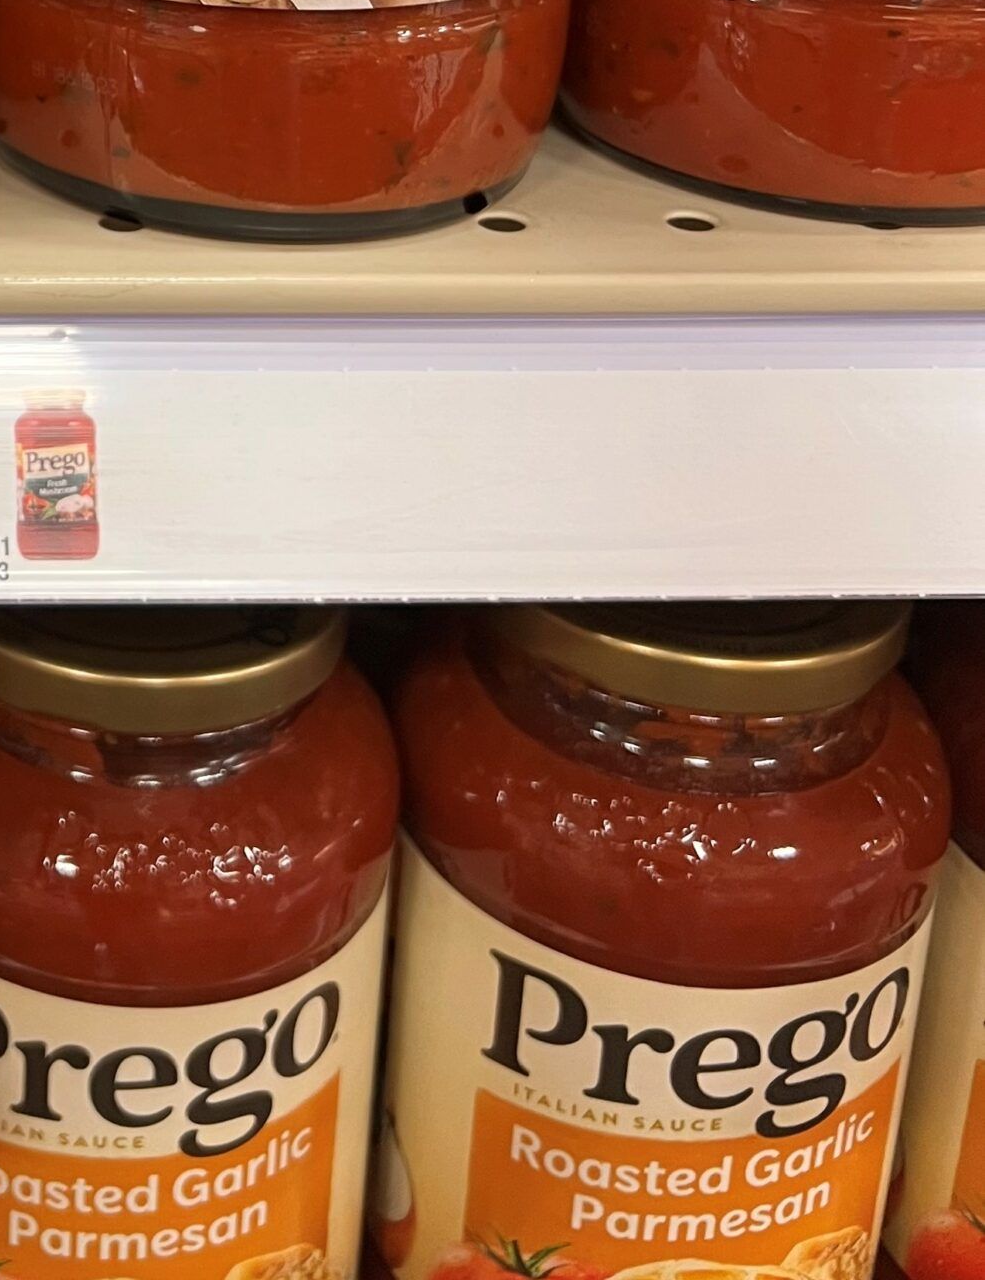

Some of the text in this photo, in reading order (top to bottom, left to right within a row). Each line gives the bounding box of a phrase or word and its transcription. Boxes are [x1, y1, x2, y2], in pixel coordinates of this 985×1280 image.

[25, 451, 86, 477] Prego
[480, 948, 911, 1139] Prego
[514, 1082, 723, 1133] ITALIAN SAUCE
[58, 1132, 146, 1150] SAUCE
[172, 1126, 312, 1209] Garlic
[510, 1109, 875, 1197] Roasted Garlic
[9, 1199, 268, 1261] Parmesan
[572, 1180, 831, 1243] Parmesan
